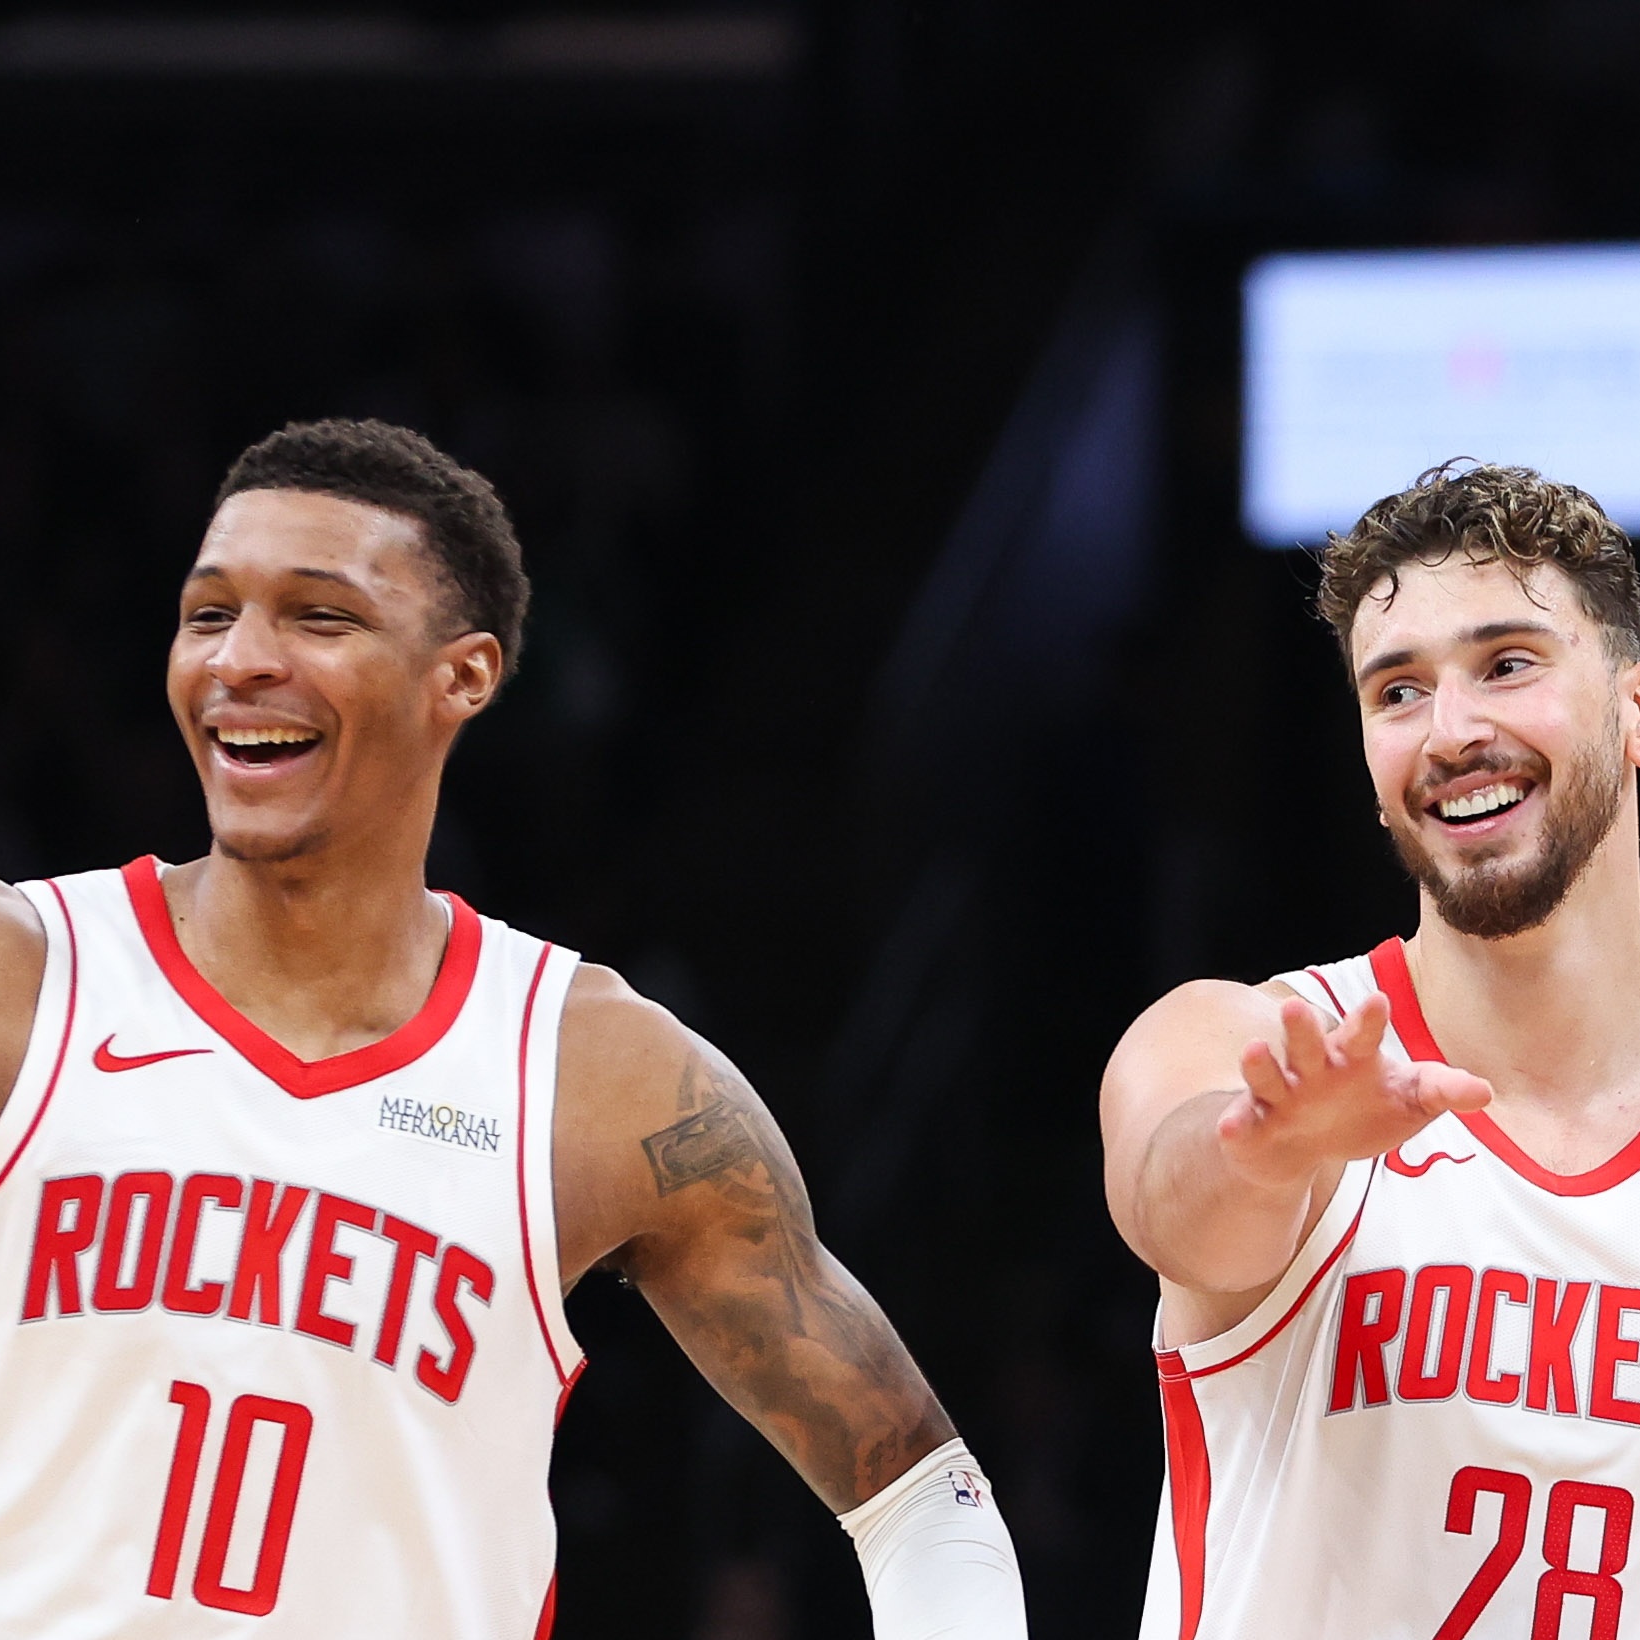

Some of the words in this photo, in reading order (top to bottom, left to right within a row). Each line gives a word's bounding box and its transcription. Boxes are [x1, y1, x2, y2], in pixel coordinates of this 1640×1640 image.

[378, 1108, 499, 1152] HERMANN
[379, 1094, 501, 1137] MEMORIAL
[18, 1170, 498, 1406] ROCKETS
[146, 1379, 314, 1618] 10
